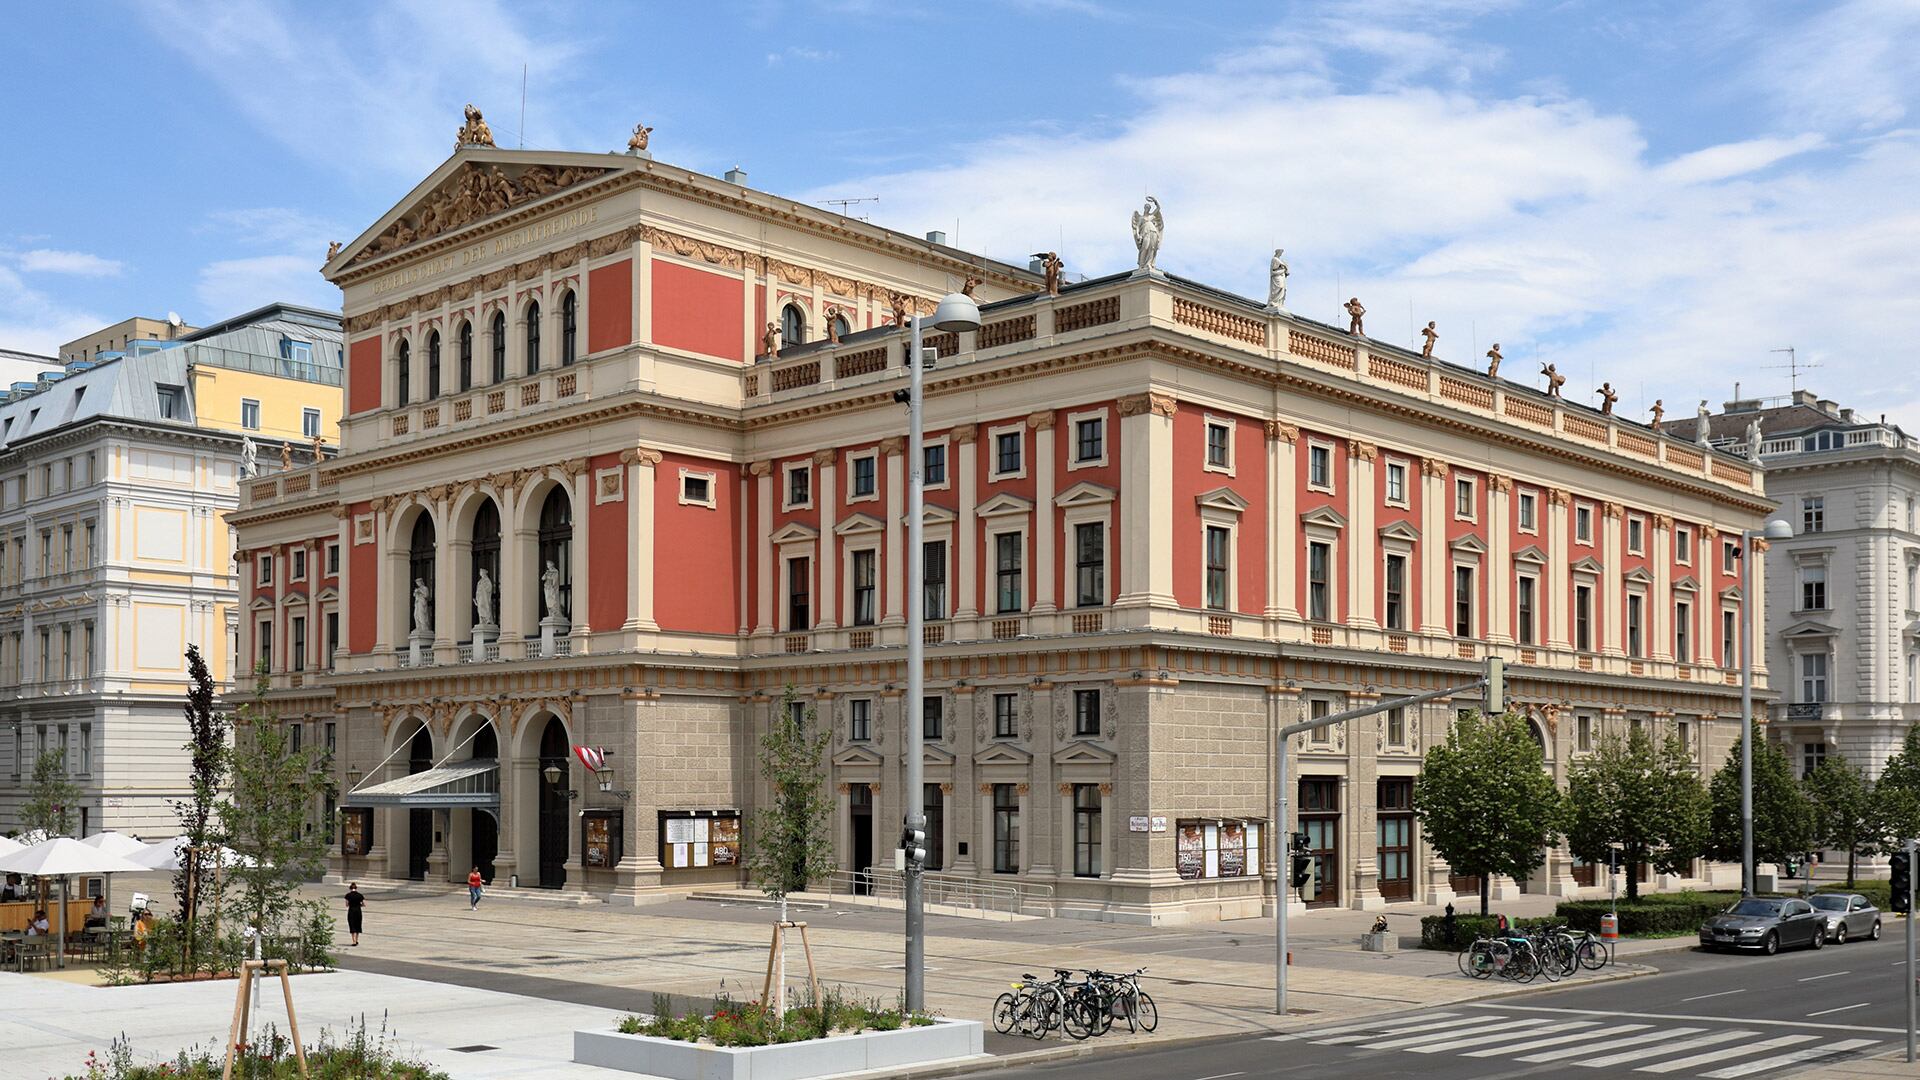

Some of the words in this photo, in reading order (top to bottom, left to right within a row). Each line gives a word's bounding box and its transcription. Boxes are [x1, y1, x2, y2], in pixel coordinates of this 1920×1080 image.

[374, 256, 454, 293] GESELLSCHAFT
[463, 246, 487, 265] DER
[495, 207, 598, 254] MUSIKFREUNDE
